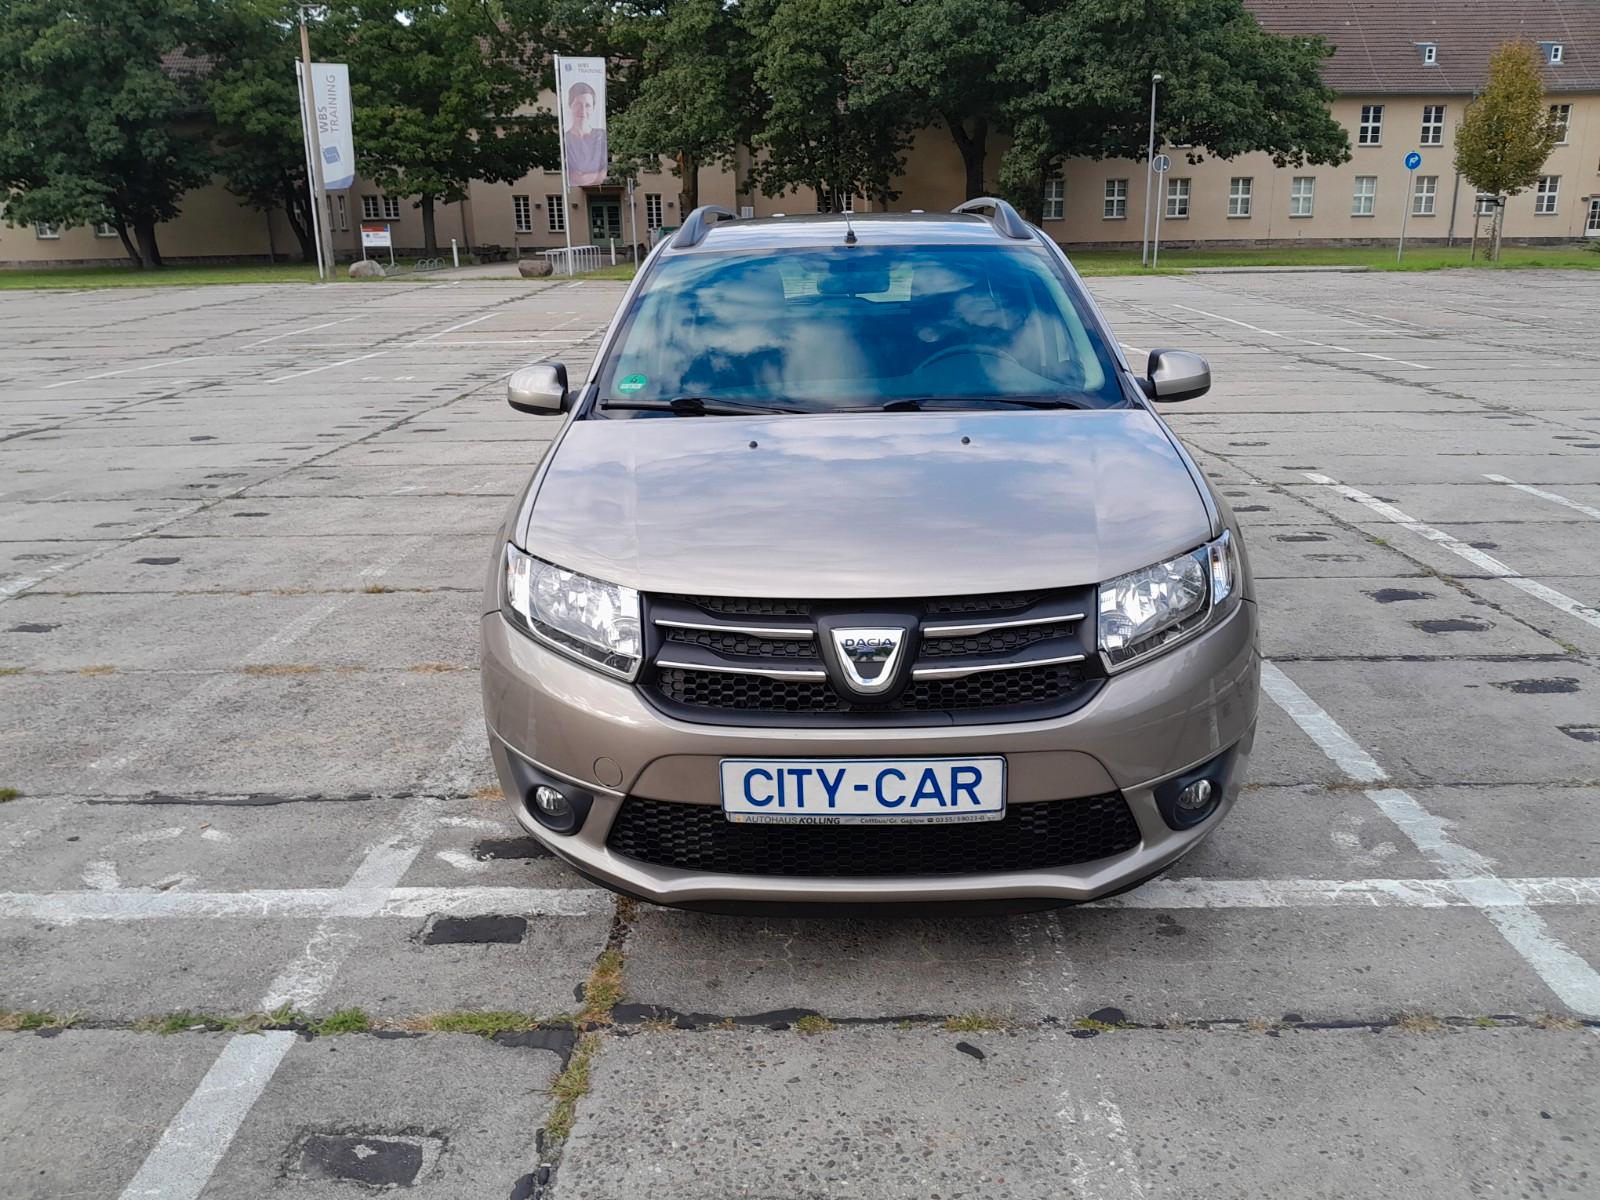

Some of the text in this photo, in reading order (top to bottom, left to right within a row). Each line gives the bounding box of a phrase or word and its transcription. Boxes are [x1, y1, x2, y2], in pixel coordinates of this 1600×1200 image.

[326, 74, 339, 134] TRAINING
[317, 105, 329, 134] WBS
[845, 638, 893, 647] DACIA
[743, 765, 983, 808] CITY-CAR
[745, 815, 840, 825] AUTOHAUS KOLLING
